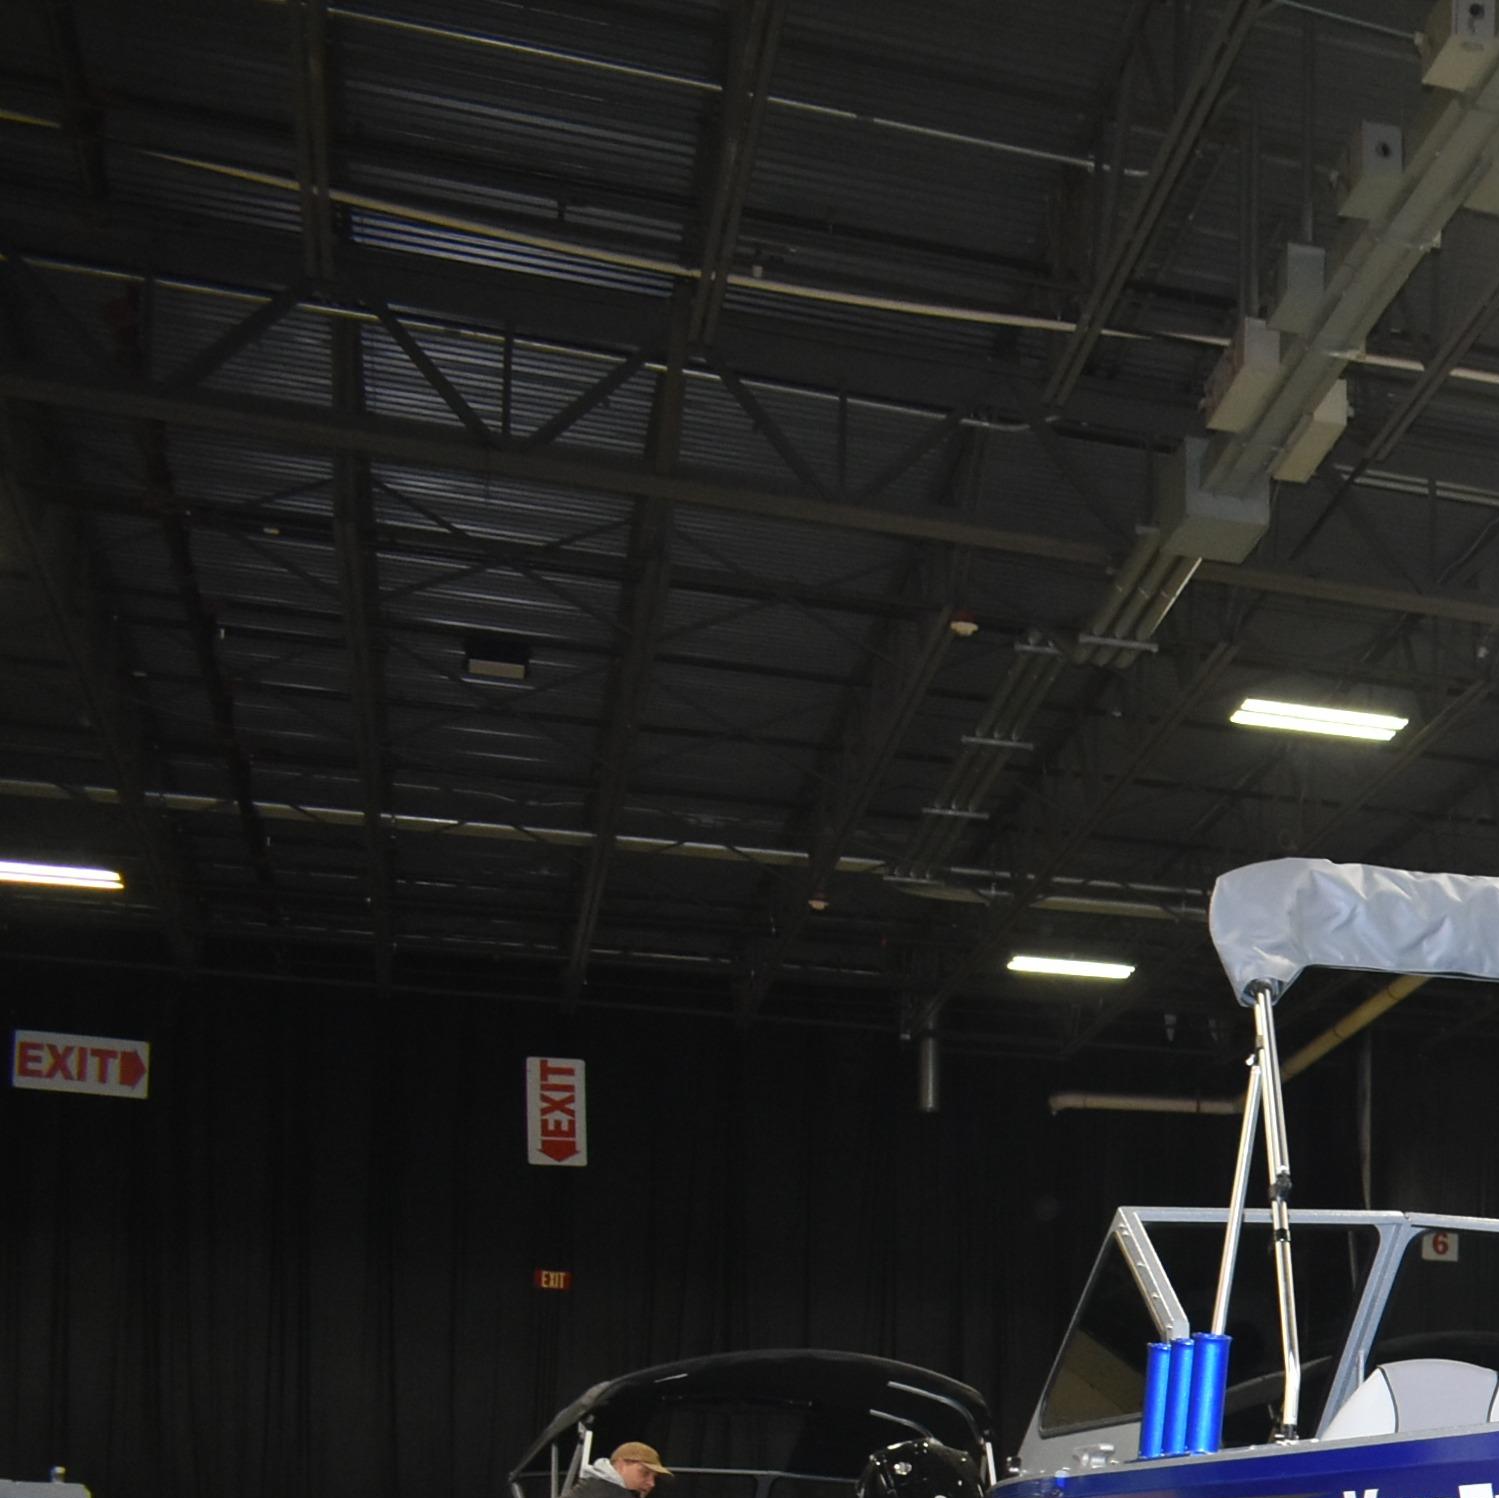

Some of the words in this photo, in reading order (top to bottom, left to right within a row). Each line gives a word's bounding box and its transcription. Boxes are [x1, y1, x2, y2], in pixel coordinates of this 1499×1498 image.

[16, 1041, 120, 1084] EXIT
[539, 1060, 576, 1138] EXIT
[1432, 1231, 1449, 1256] 6
[541, 1270, 567, 1289] EXIT
